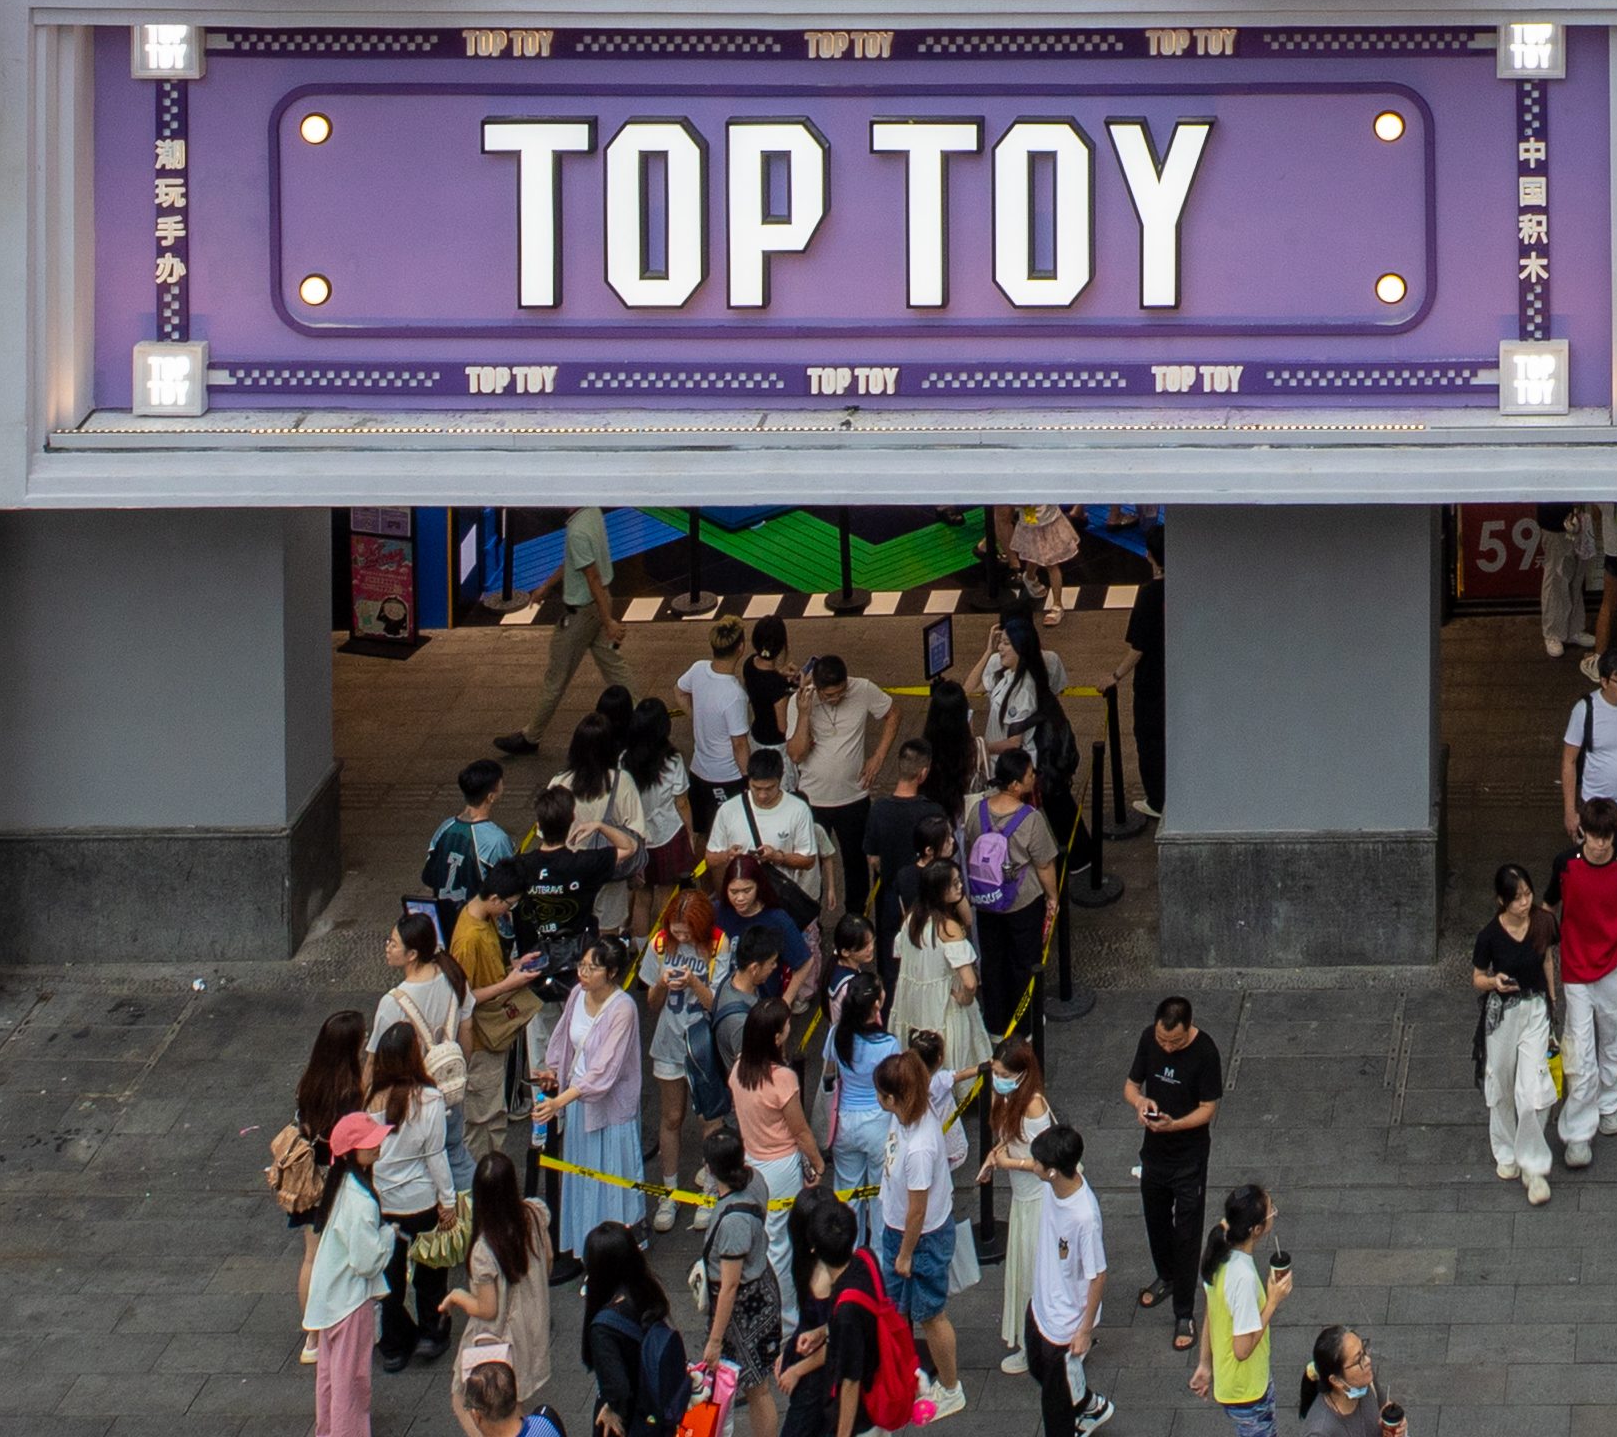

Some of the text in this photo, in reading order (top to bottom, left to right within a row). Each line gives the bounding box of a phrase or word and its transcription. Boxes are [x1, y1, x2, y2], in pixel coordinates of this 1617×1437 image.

[146, 25, 189, 43] TOP
[463, 29, 554, 57] TOP TOY
[146, 44, 189, 70] TOY
[154, 139, 186, 286] 潮玩手办
[481, 116, 1217, 309] TOP TOY
[1518, 138, 1548, 282] 中国积木
[466, 367, 557, 394] TOP TOY
[1513, 357, 1555, 380] TOP
[1513, 380, 1555, 405] TOY
[1476, 518, 1541, 572] 59
